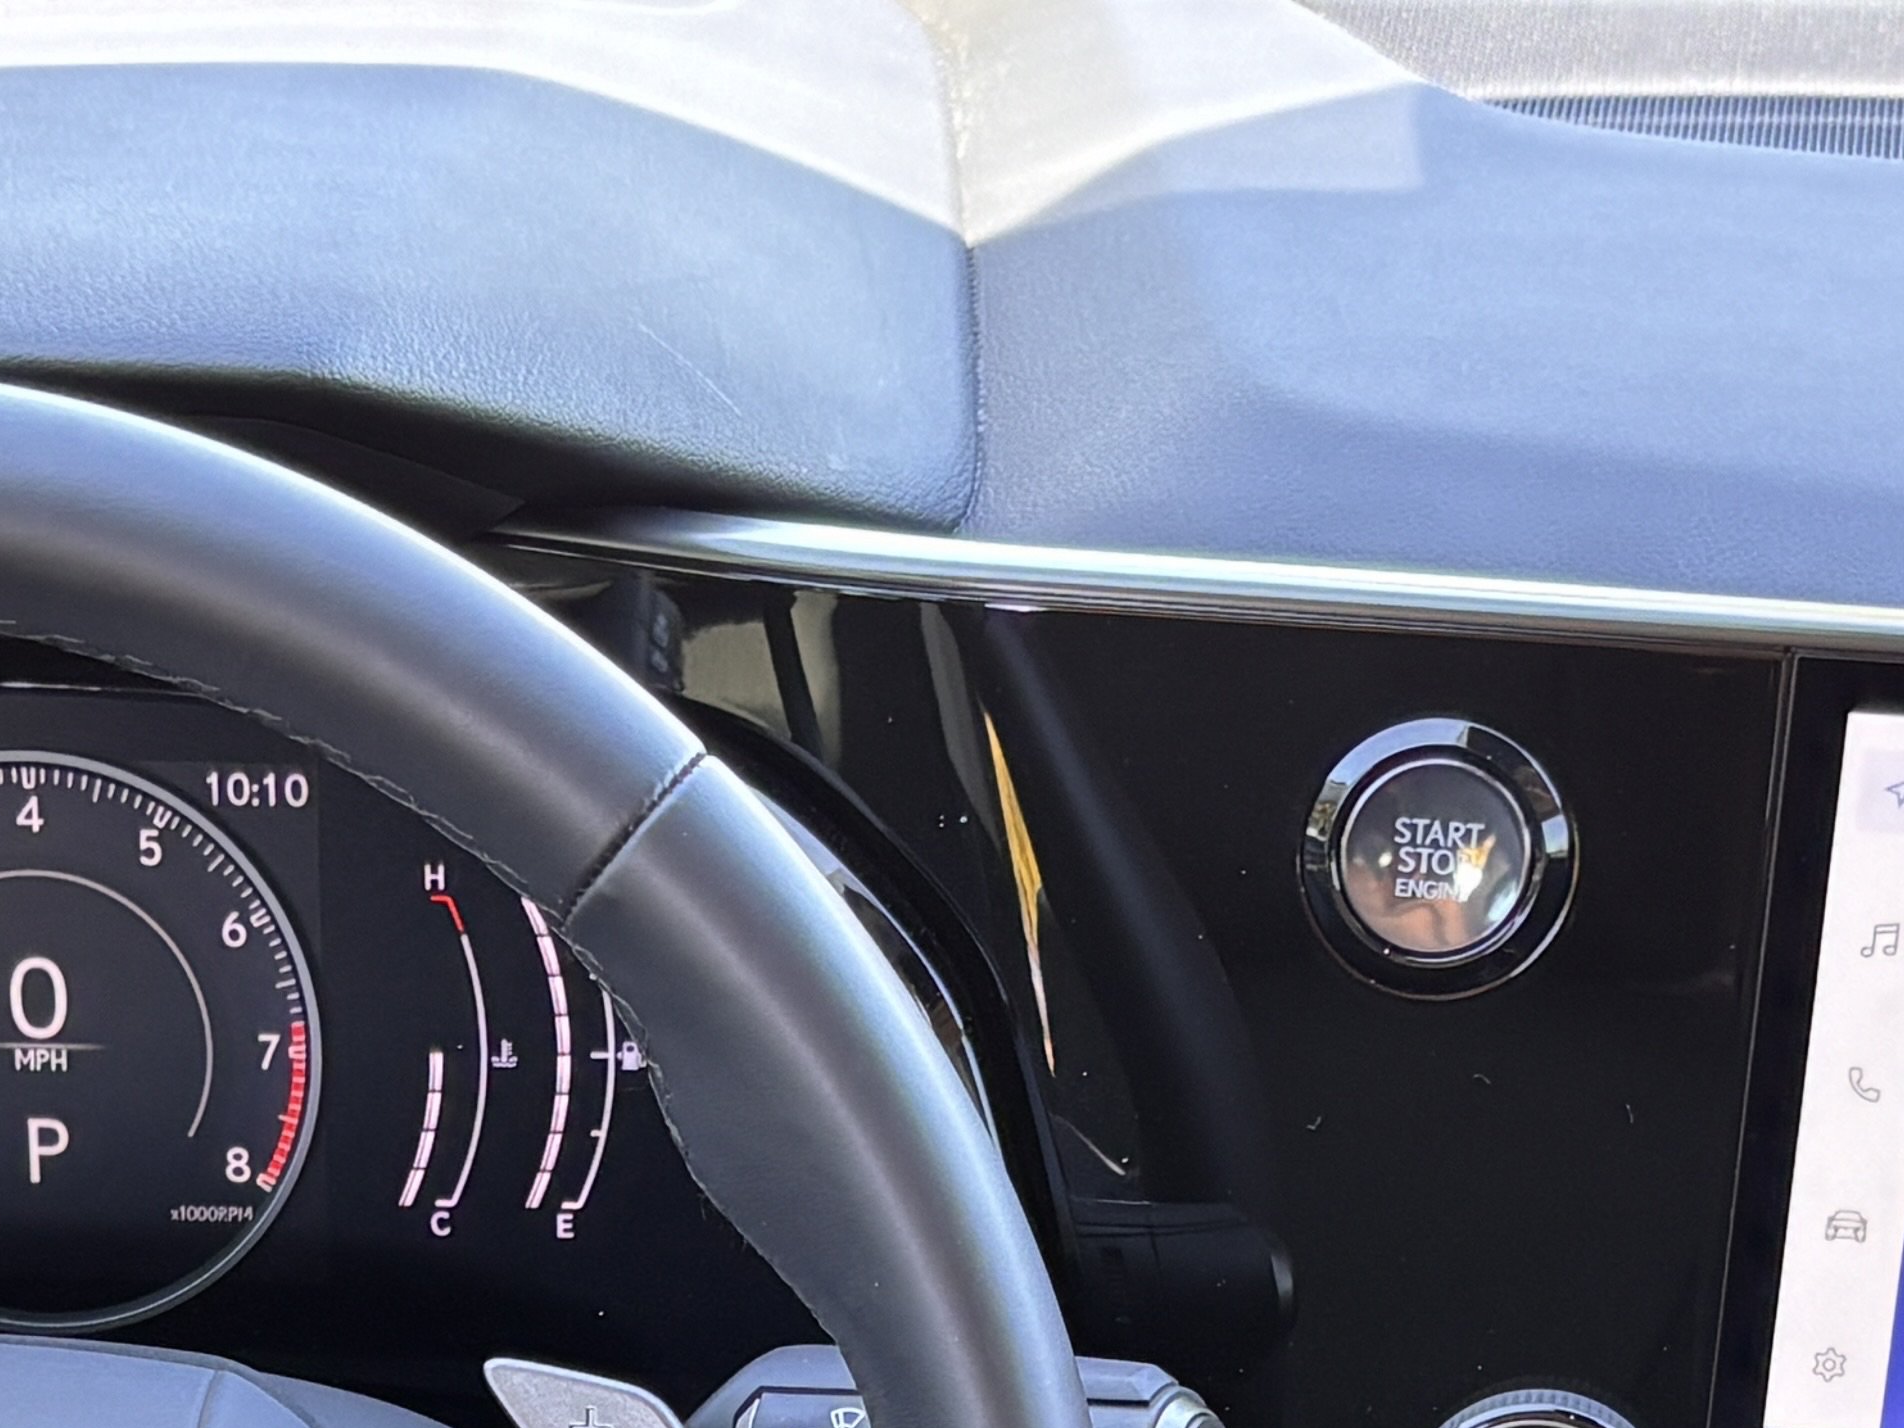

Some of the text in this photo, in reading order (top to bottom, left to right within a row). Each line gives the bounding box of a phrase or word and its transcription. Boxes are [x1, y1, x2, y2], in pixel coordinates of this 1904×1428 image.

[205, 772, 309, 809] 10:10
[16, 795, 44, 833] 4
[138, 829, 163, 867] 5
[1394, 816, 1486, 850] START
[424, 865, 446, 891] H
[1395, 878, 1469, 901] ENGIN
[221, 914, 247, 949] 6
[8, 956, 68, 1041] 0
[13, 1047, 68, 1073] MPH
[257, 1035, 280, 1070] 7
[27, 1117, 69, 1184] P
[225, 1146, 251, 1183] 8
[430, 1211, 451, 1238] C
[556, 1213, 575, 1239] E
